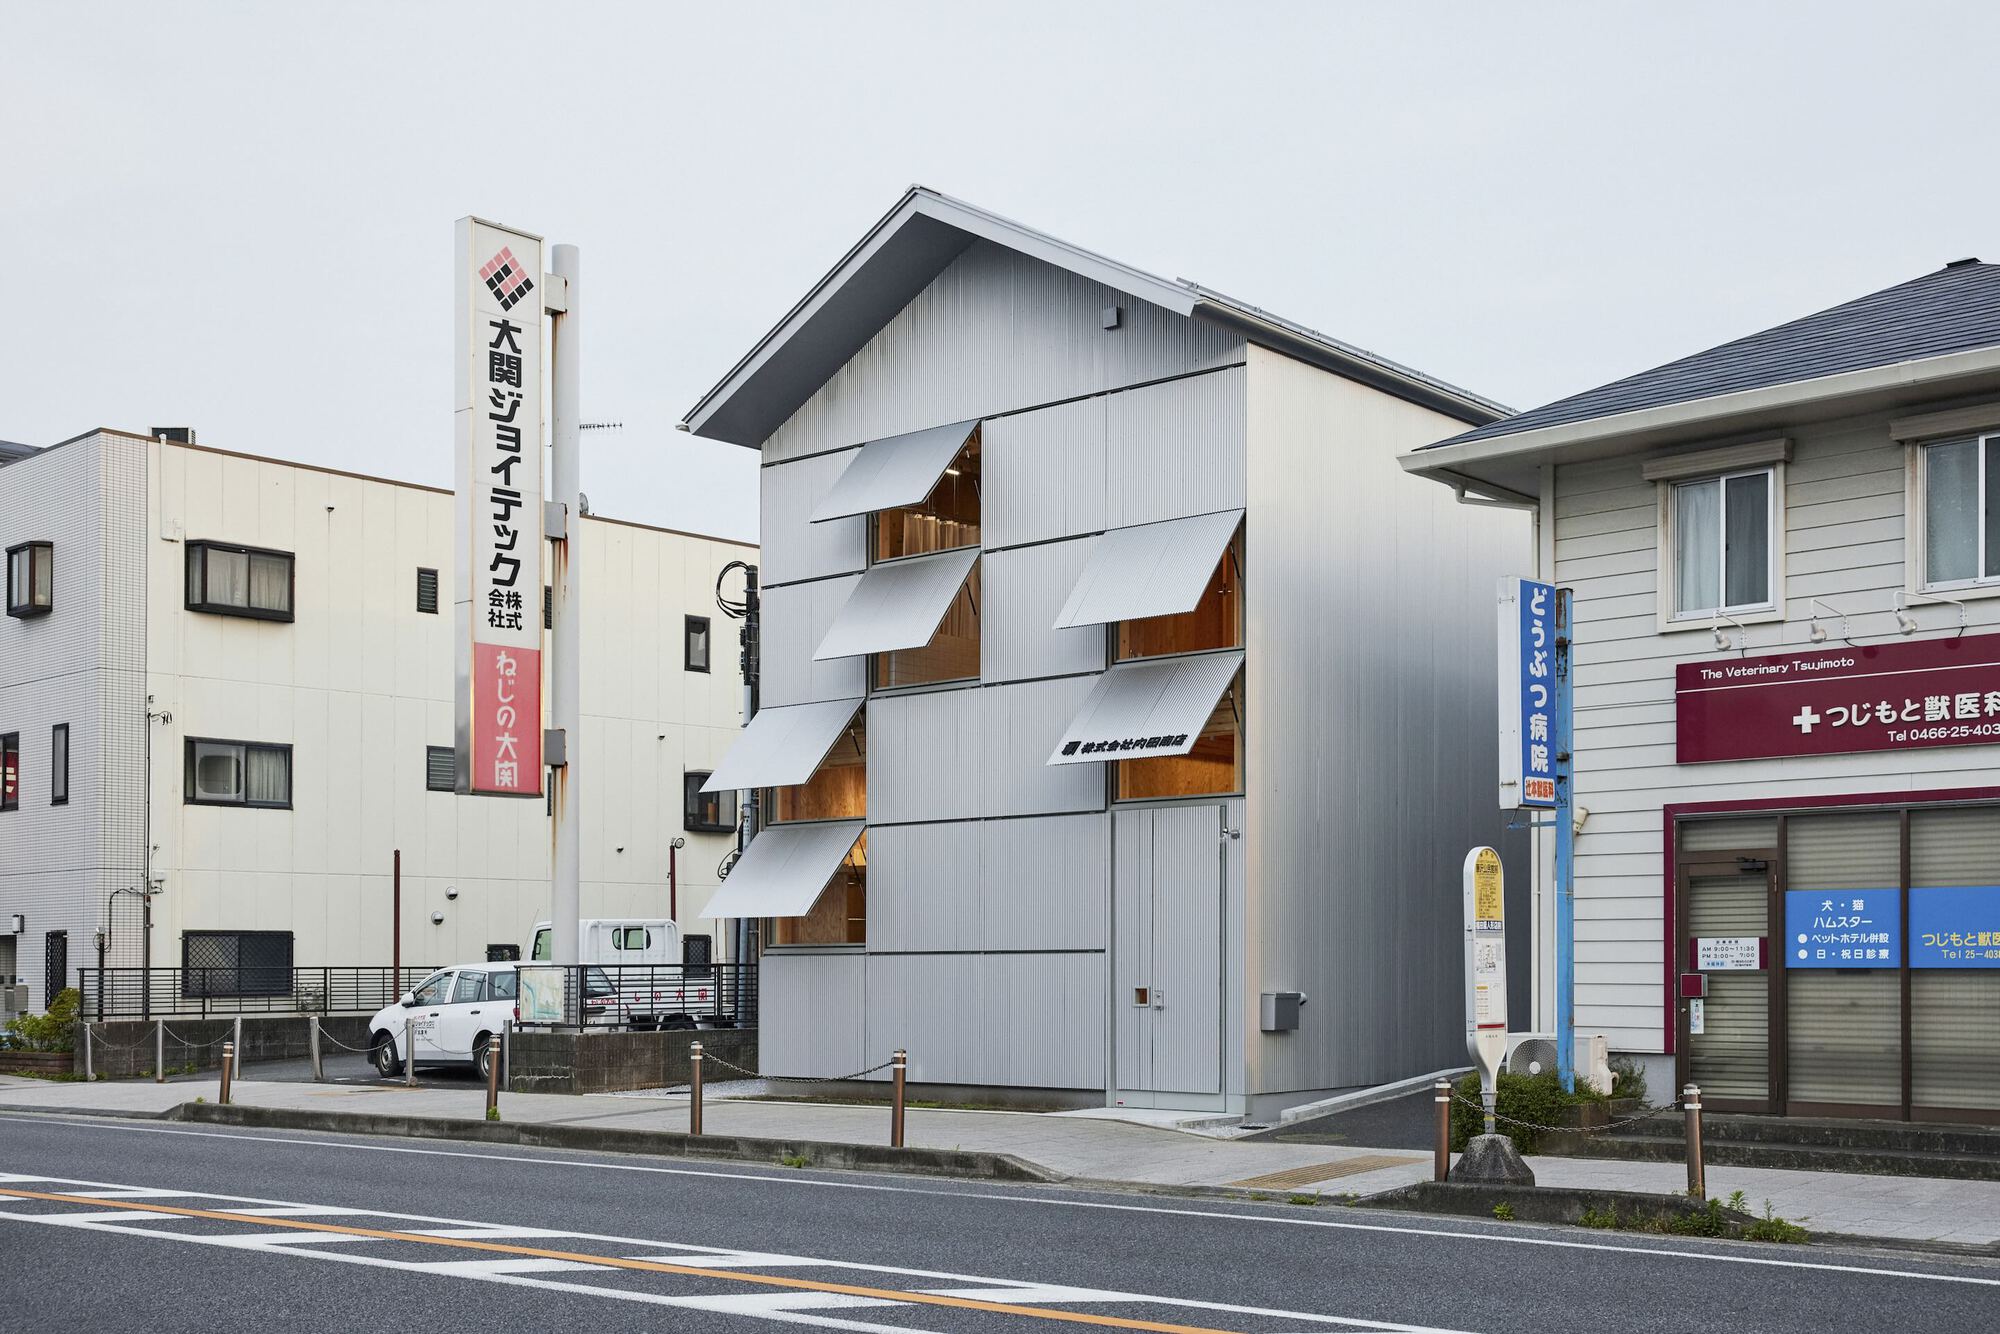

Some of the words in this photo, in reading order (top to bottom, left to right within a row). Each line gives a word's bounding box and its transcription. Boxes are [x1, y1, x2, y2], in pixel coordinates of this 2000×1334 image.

[488, 318, 523, 588] 大関ジョイテック
[1700, 669, 1723, 680] The
[1725, 664, 1789, 678] Veterinary
[1792, 657, 1855, 672] Tsujimoto
[1529, 587, 1549, 773] どうぶつ病院
[494, 650, 519, 788] ねじの大関
[1081, 733, 1189, 755] 株式会社内田商店
[1888, 729, 1907, 742] Tel
[1813, 916, 1873, 929] ハムスター
[1811, 932, 1890, 944] ペットホテル併設
[1941, 949, 1961, 959] Tel
